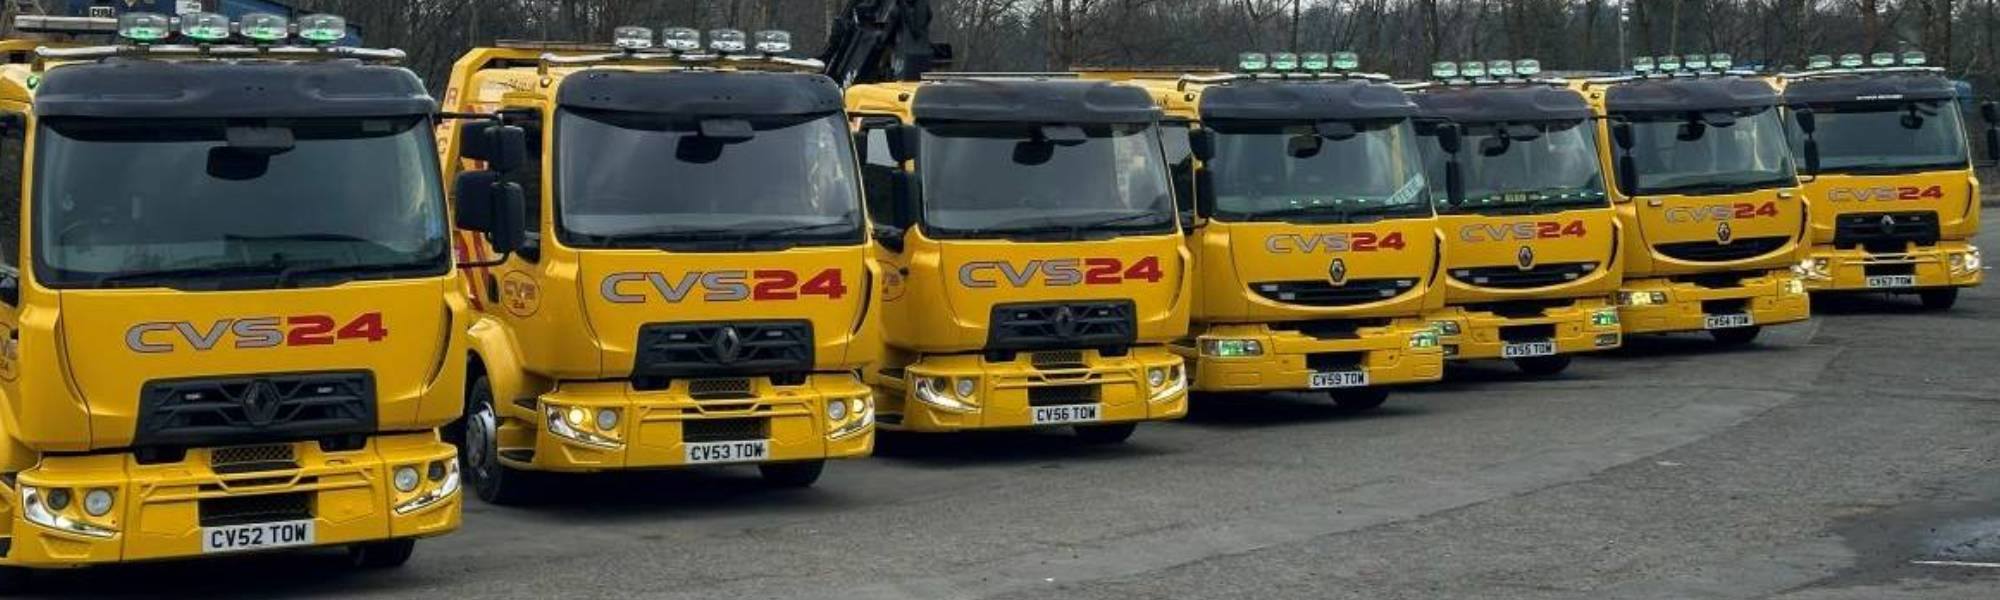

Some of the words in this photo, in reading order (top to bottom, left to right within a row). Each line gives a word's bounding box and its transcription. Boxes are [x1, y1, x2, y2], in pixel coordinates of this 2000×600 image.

[1829, 185, 1943, 201] CVS24
[1665, 202, 1778, 222] CVS24
[1461, 220, 1586, 241] CVS24
[1266, 232, 1405, 253] CVS24
[958, 256, 1164, 288] CVS24
[600, 267, 848, 304] CVS24
[125, 311, 388, 353] CVS24
[1312, 374, 1342, 386] CV59
[1345, 373, 1365, 384] TOW
[1036, 407, 1071, 422] CV56
[1074, 406, 1096, 420] TOW
[690, 444, 732, 462] CV53
[735, 443, 763, 459] TOW
[210, 527, 264, 549] CV52
[271, 524, 307, 543] TOW
